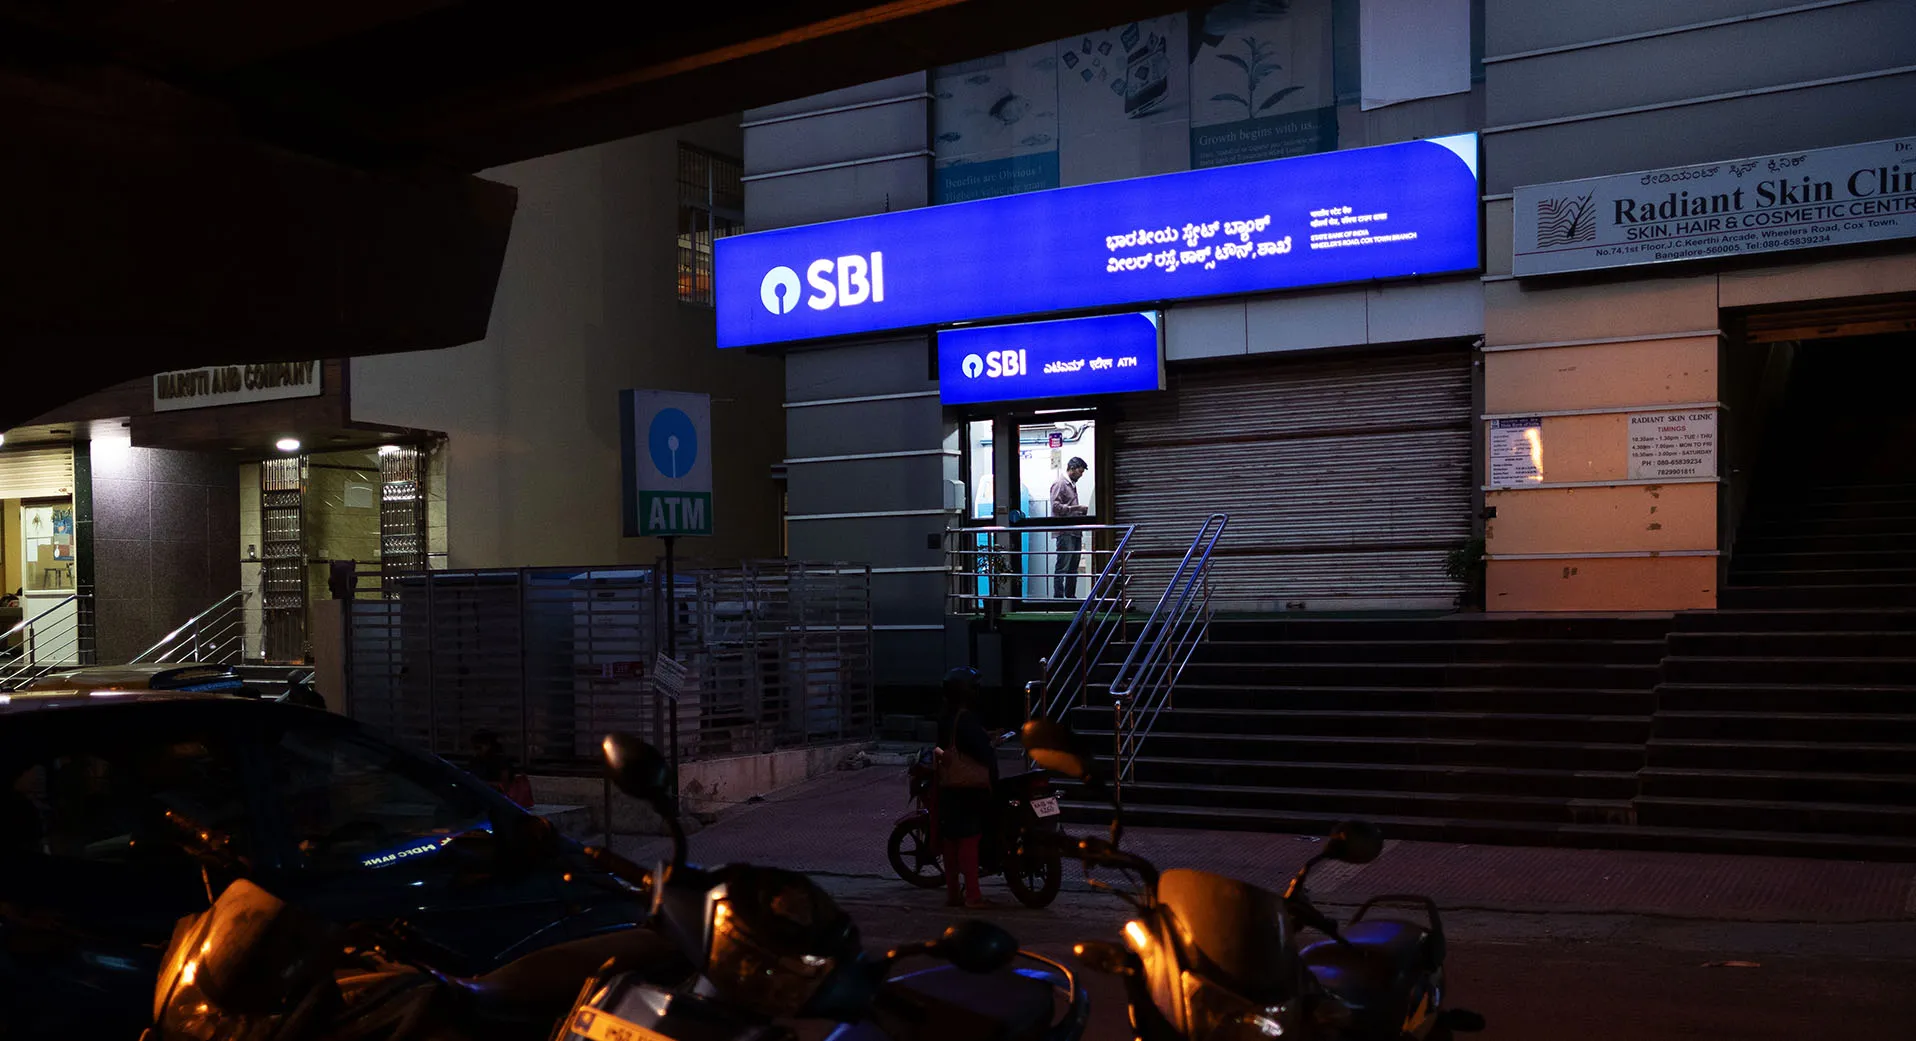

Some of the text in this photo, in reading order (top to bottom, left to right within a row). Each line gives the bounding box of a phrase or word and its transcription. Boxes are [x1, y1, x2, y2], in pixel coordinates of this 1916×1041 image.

[1200, 132, 1237, 145] Growth
[1240, 128, 1272, 141] begins
[1275, 121, 1297, 134] with
[945, 174, 980, 189] Benefits
[983, 174, 997, 183] are
[1000, 166, 1035, 179] Obvious
[1612, 187, 1744, 225] Radiant
[1756, 176, 1833, 209] Skin
[1676, 218, 1720, 234] HAIR
[1726, 216, 1738, 229] &
[1743, 204, 1845, 227] COSMETIC
[1106, 214, 1271, 252] ಭಾರತೀಯ ಸ್ಟೇಟ್ ಬ್ಯಾಂಕ್
[1328, 231, 1343, 240] BANK
[1344, 230, 1352, 238] OF
[1352, 228, 1370, 237] INDIA
[1360, 237, 1373, 245] COX
[1373, 234, 1391, 243] TOWN
[1391, 231, 1418, 241] BRANCH
[1722, 233, 1758, 244] Arcade,
[1761, 228, 1808, 239] Wheelers
[1811, 224, 1840, 234] Road,
[1843, 222, 1864, 230] Cox
[807, 251, 884, 311] SBI
[986, 349, 1027, 378] SBI
[1117, 356, 1137, 369] ATM
[212, 367, 242, 394] AND
[244, 360, 314, 390] COMPANY
[1632, 415, 1664, 424] RADIANT
[1689, 413, 1712, 421] CLINIC
[648, 496, 705, 530] ATM
